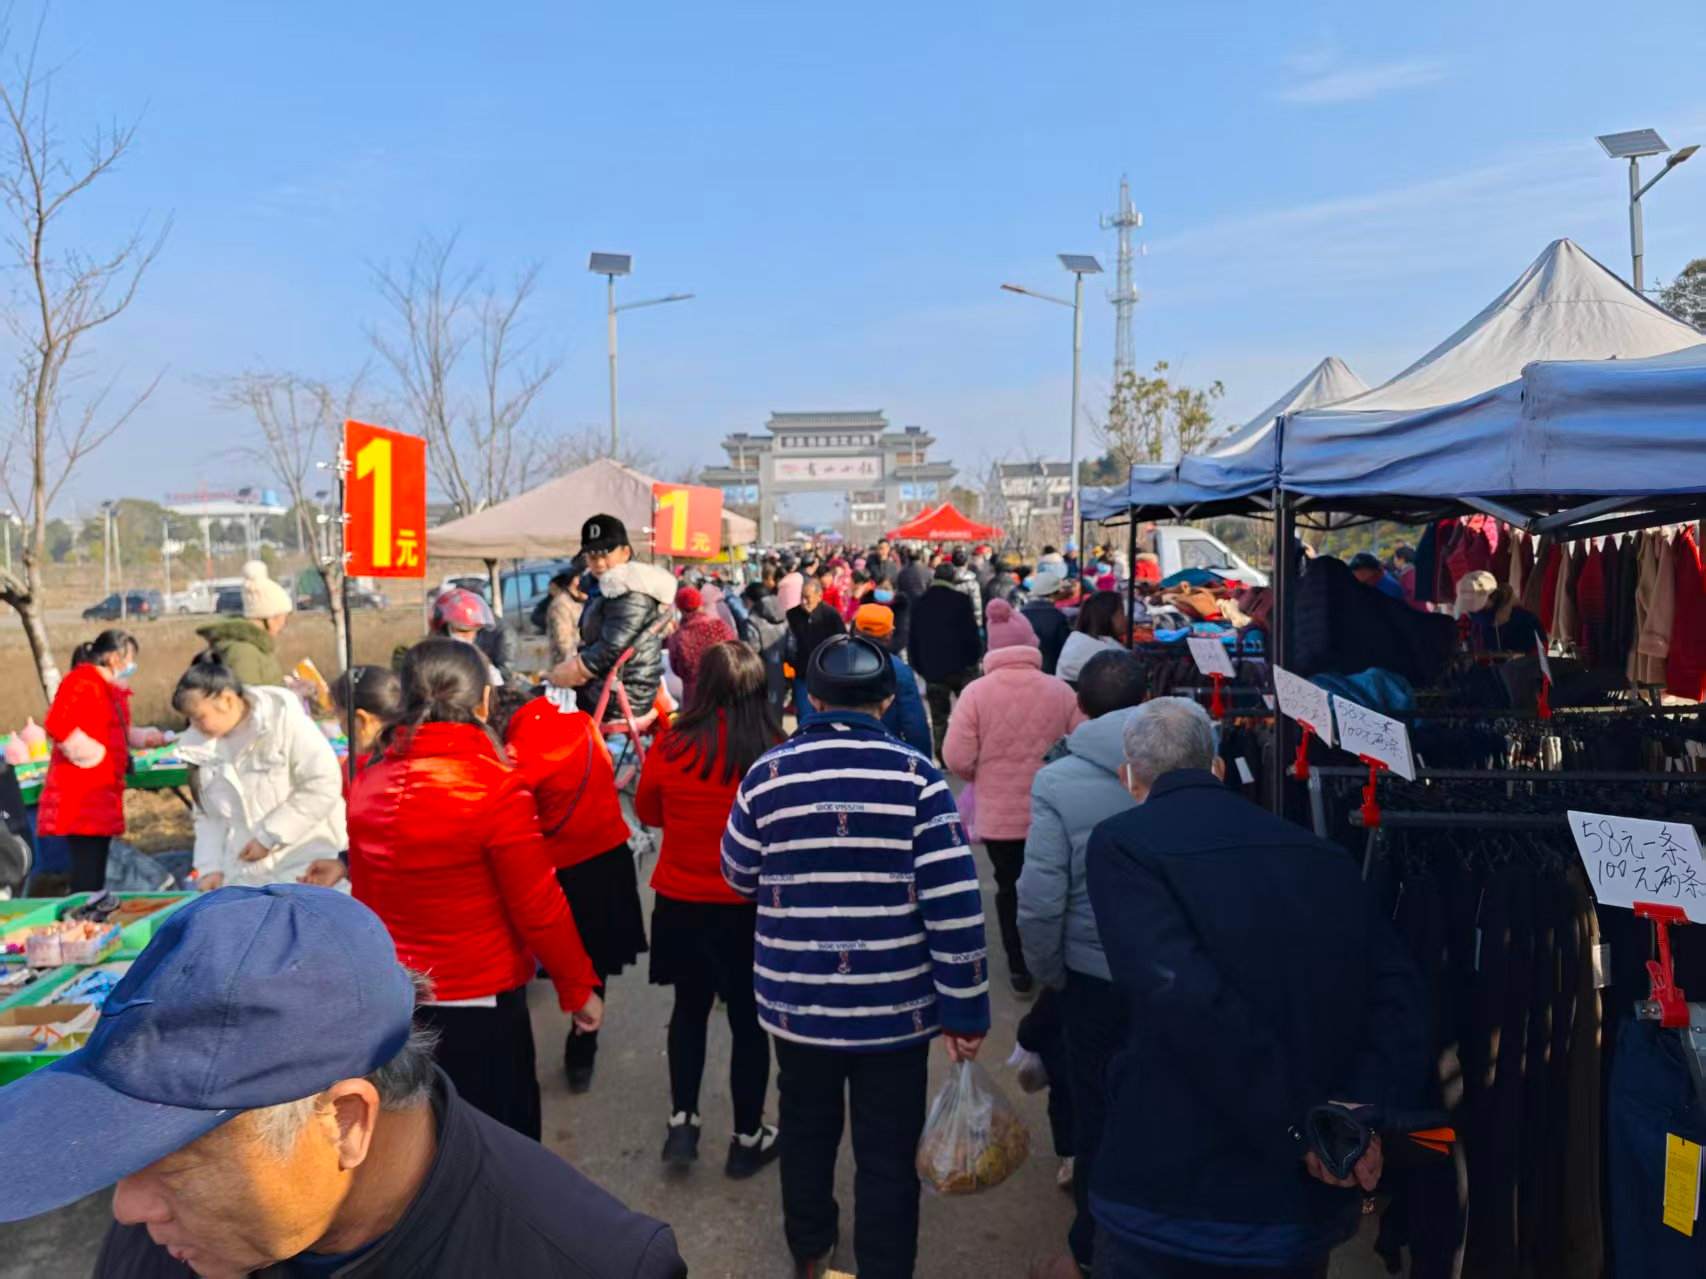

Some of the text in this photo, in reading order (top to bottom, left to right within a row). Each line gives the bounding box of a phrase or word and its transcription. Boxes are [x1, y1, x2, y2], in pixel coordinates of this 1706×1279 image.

[589, 524, 601, 539] D
[1582, 819, 1688, 866] 58元一条
